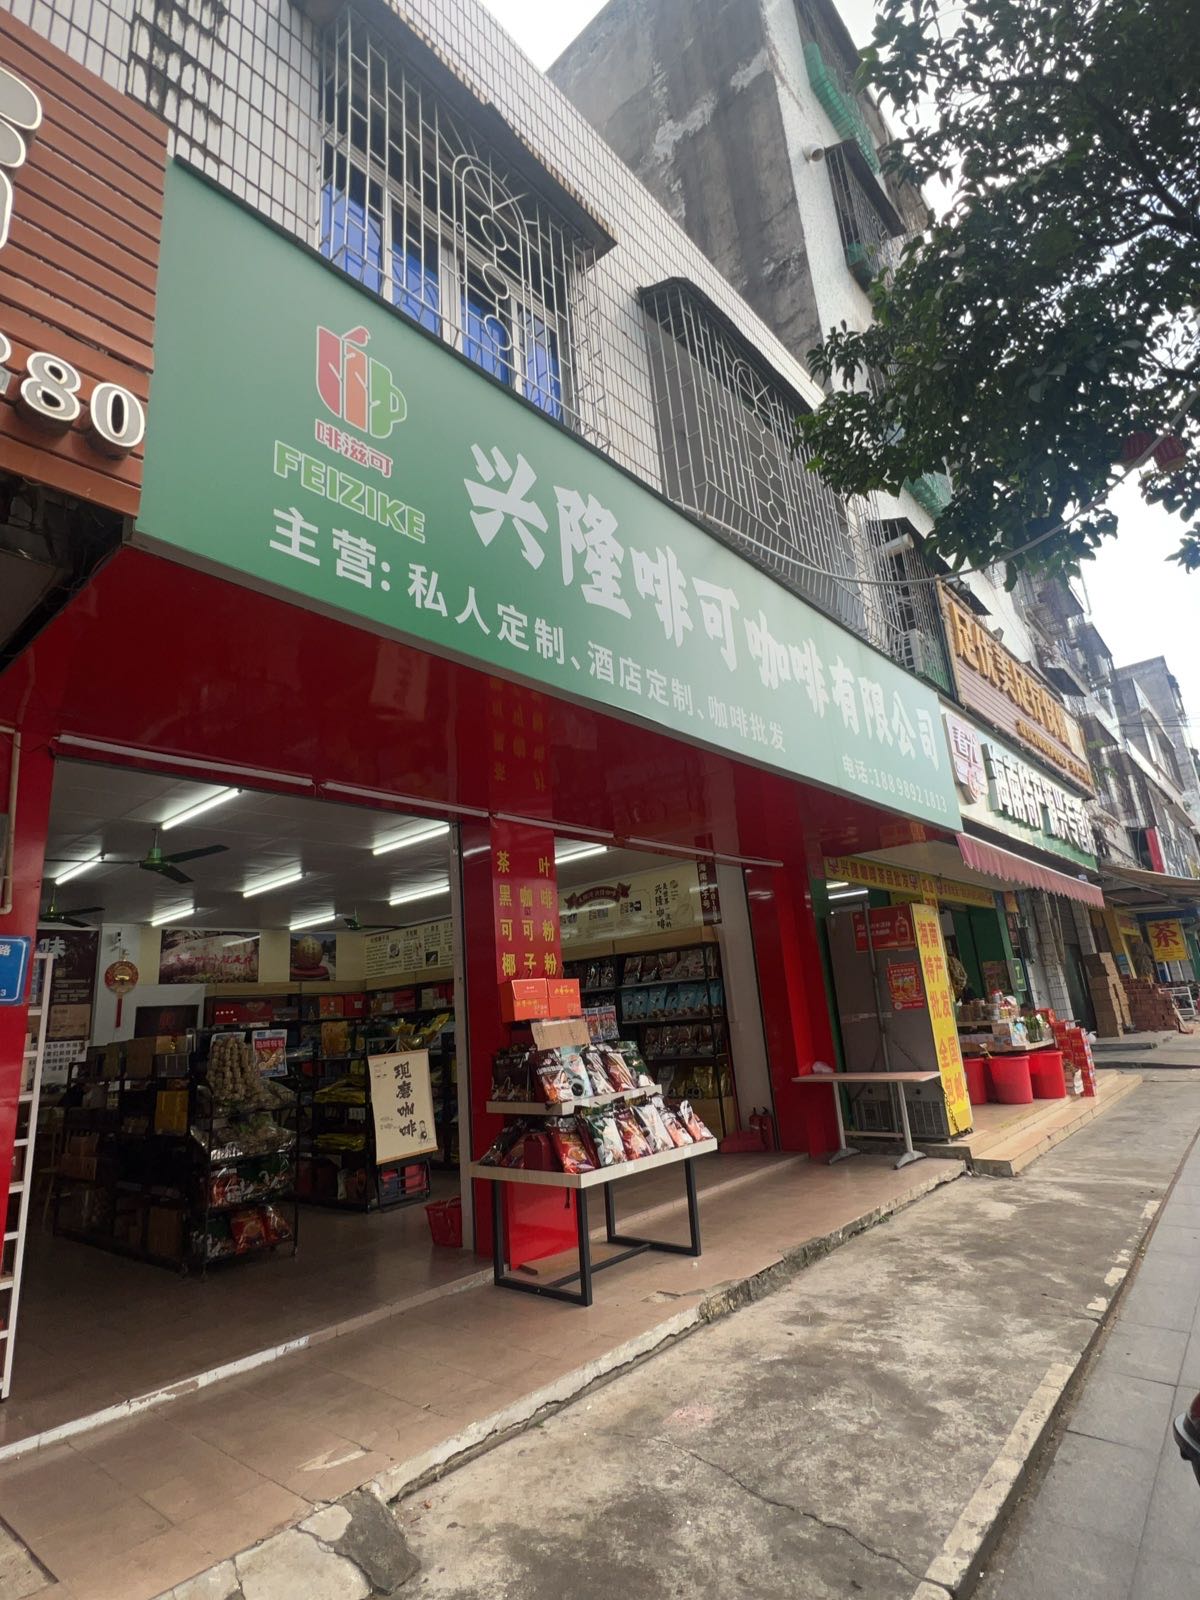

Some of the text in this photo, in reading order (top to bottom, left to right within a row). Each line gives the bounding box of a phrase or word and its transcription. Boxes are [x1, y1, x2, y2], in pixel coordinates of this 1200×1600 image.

[315, 419, 393, 478] 啡滋可
[273, 440, 426, 544] FEIZIKE
[464, 442, 939, 770] 兴隆啡可咖啡有限公司
[498, 884, 554, 909] 黑咖啡
[499, 918, 556, 942] 可可粉
[917, 920, 941, 949] 海南
[1148, 921, 1181, 948] 茶
[501, 952, 558, 977] 椰子粉
[923, 955, 946, 984] 特产
[930, 990, 952, 1020] 批发
[937, 1035, 960, 1069] 全国
[394, 1061, 418, 1138] 现磨咖啡
[944, 1074, 968, 1106] 包邮
